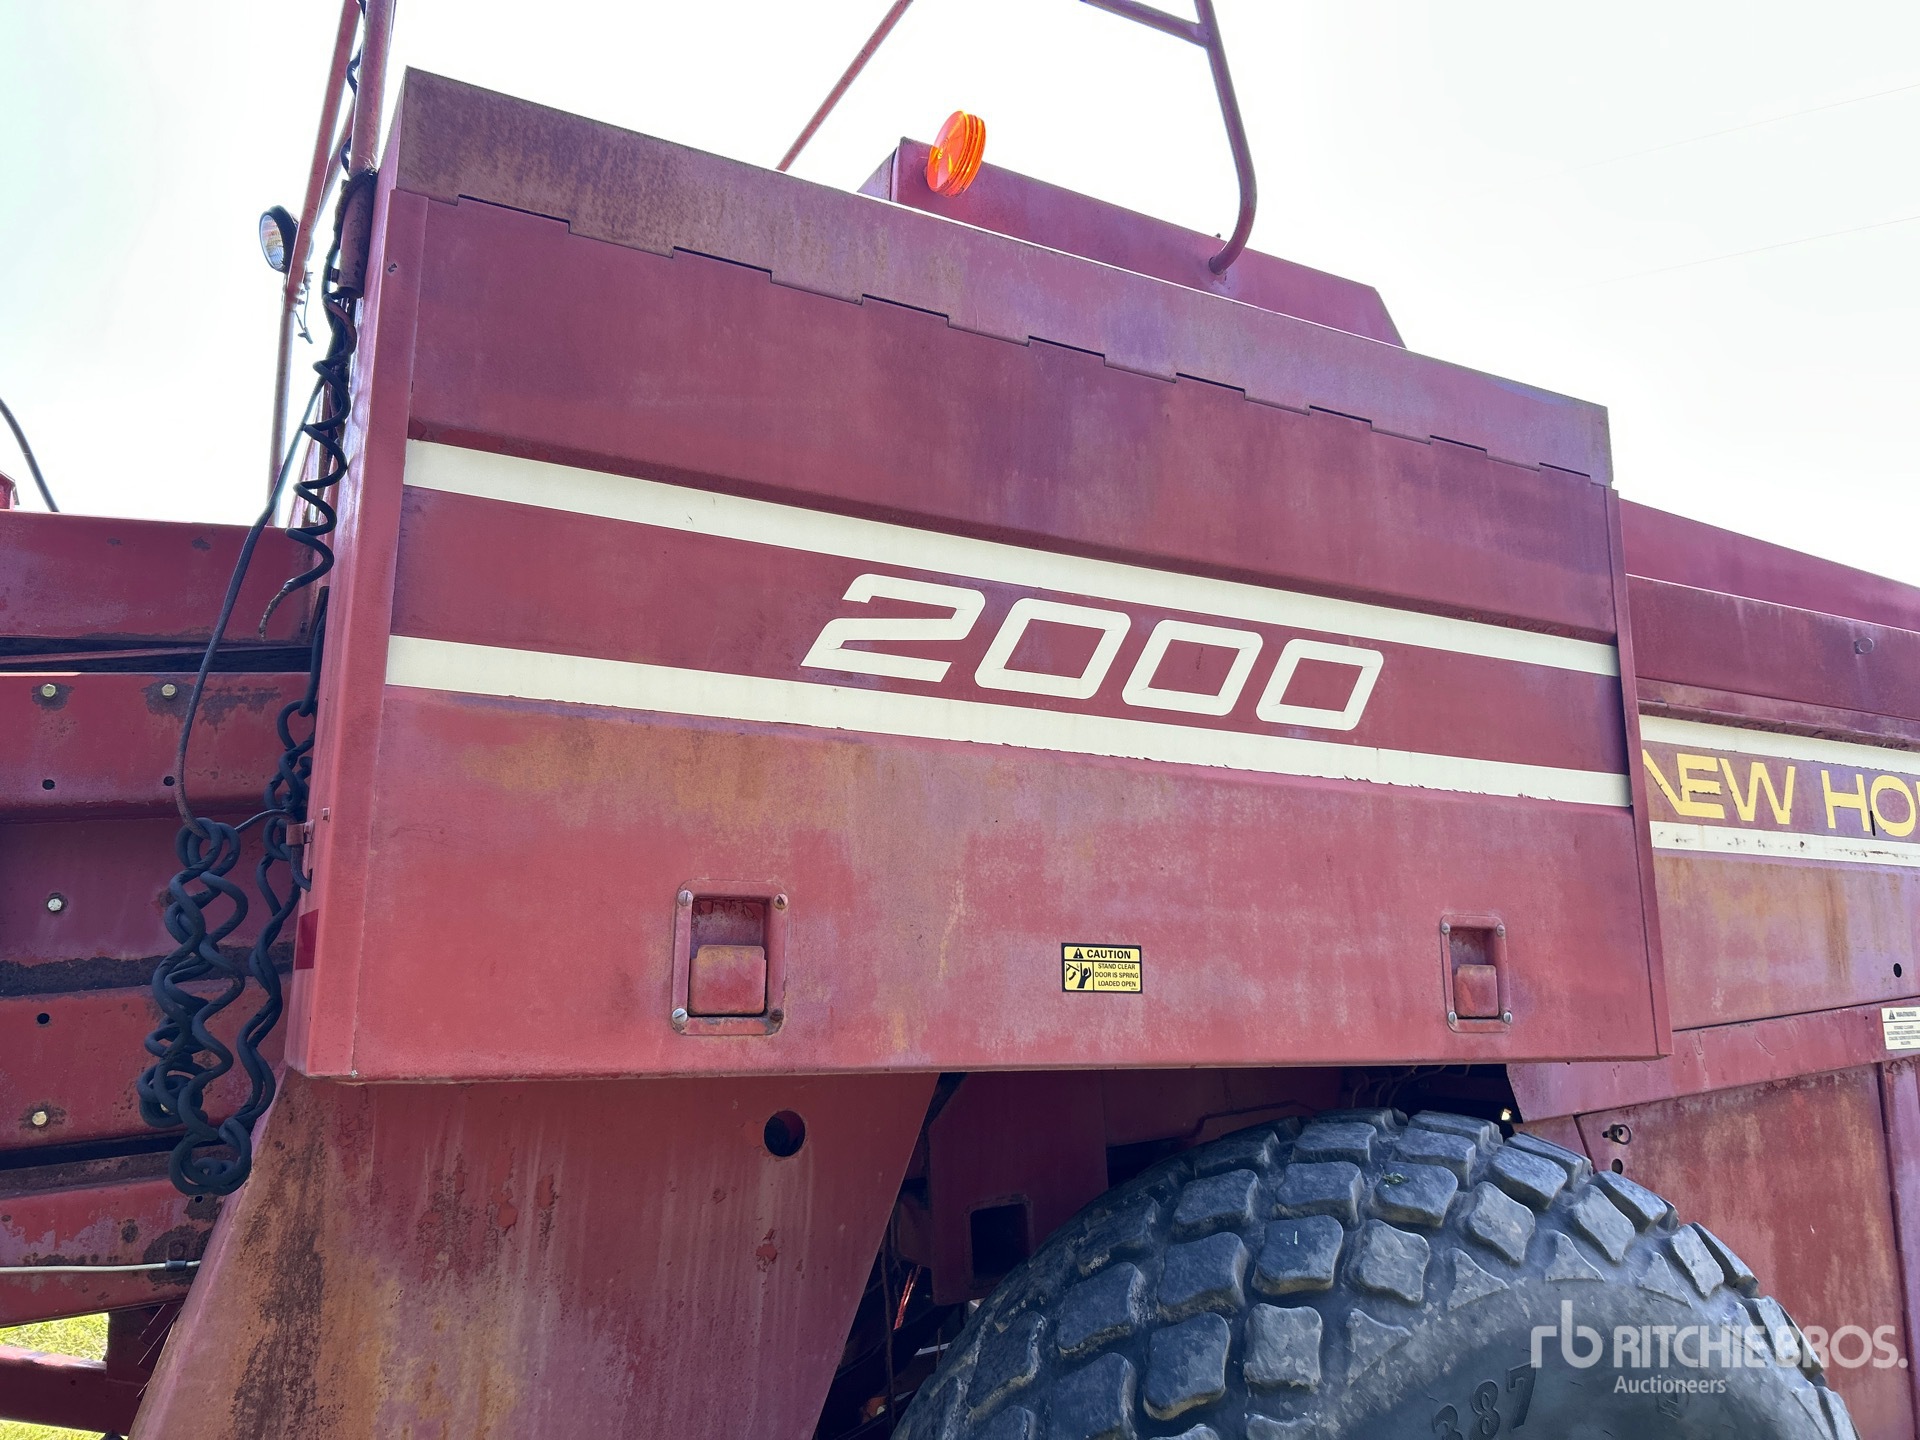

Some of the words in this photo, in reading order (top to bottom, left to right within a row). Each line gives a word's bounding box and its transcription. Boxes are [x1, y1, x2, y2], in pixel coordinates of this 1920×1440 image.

[801, 573, 1384, 731] 2000
[1643, 749, 1796, 825] NEW
[1821, 769, 1920, 837] HO
[1086, 949, 1131, 959] CAUTION
